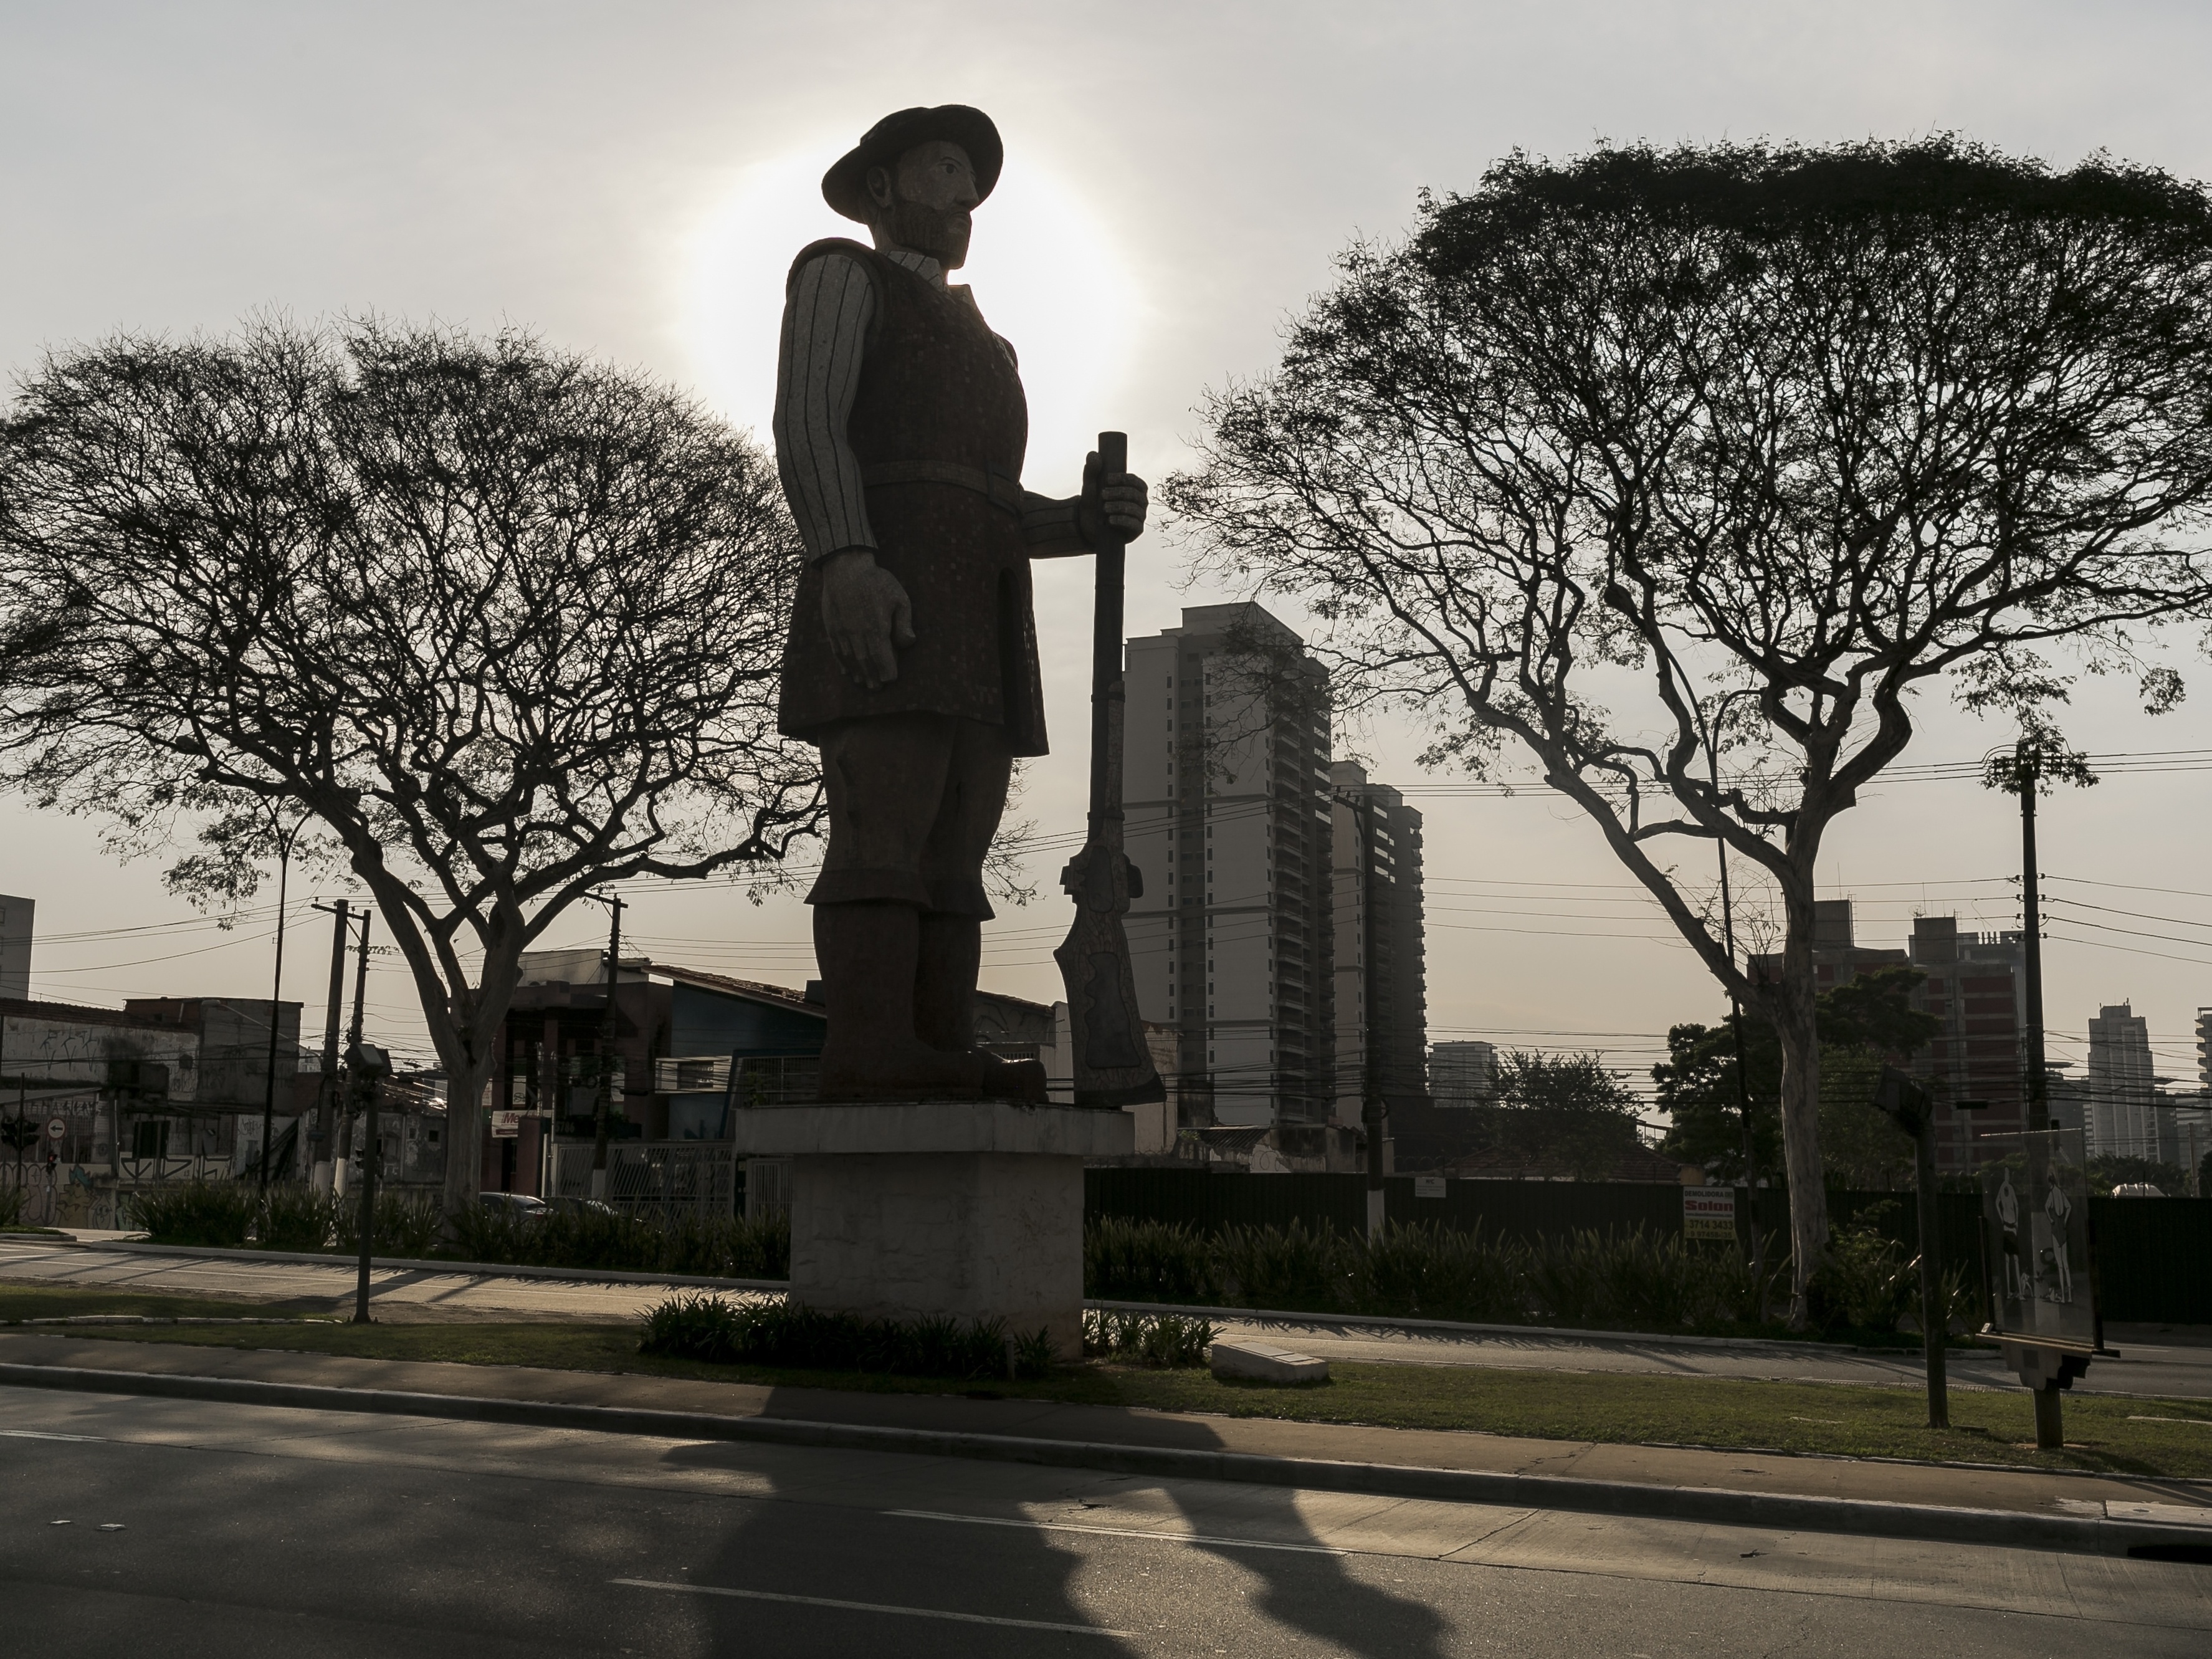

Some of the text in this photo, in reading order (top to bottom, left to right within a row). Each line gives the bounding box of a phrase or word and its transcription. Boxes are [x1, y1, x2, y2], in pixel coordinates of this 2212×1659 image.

[1685, 1200, 1733, 1212] Solon
[1689, 1220, 1733, 1230] 3714 3433
